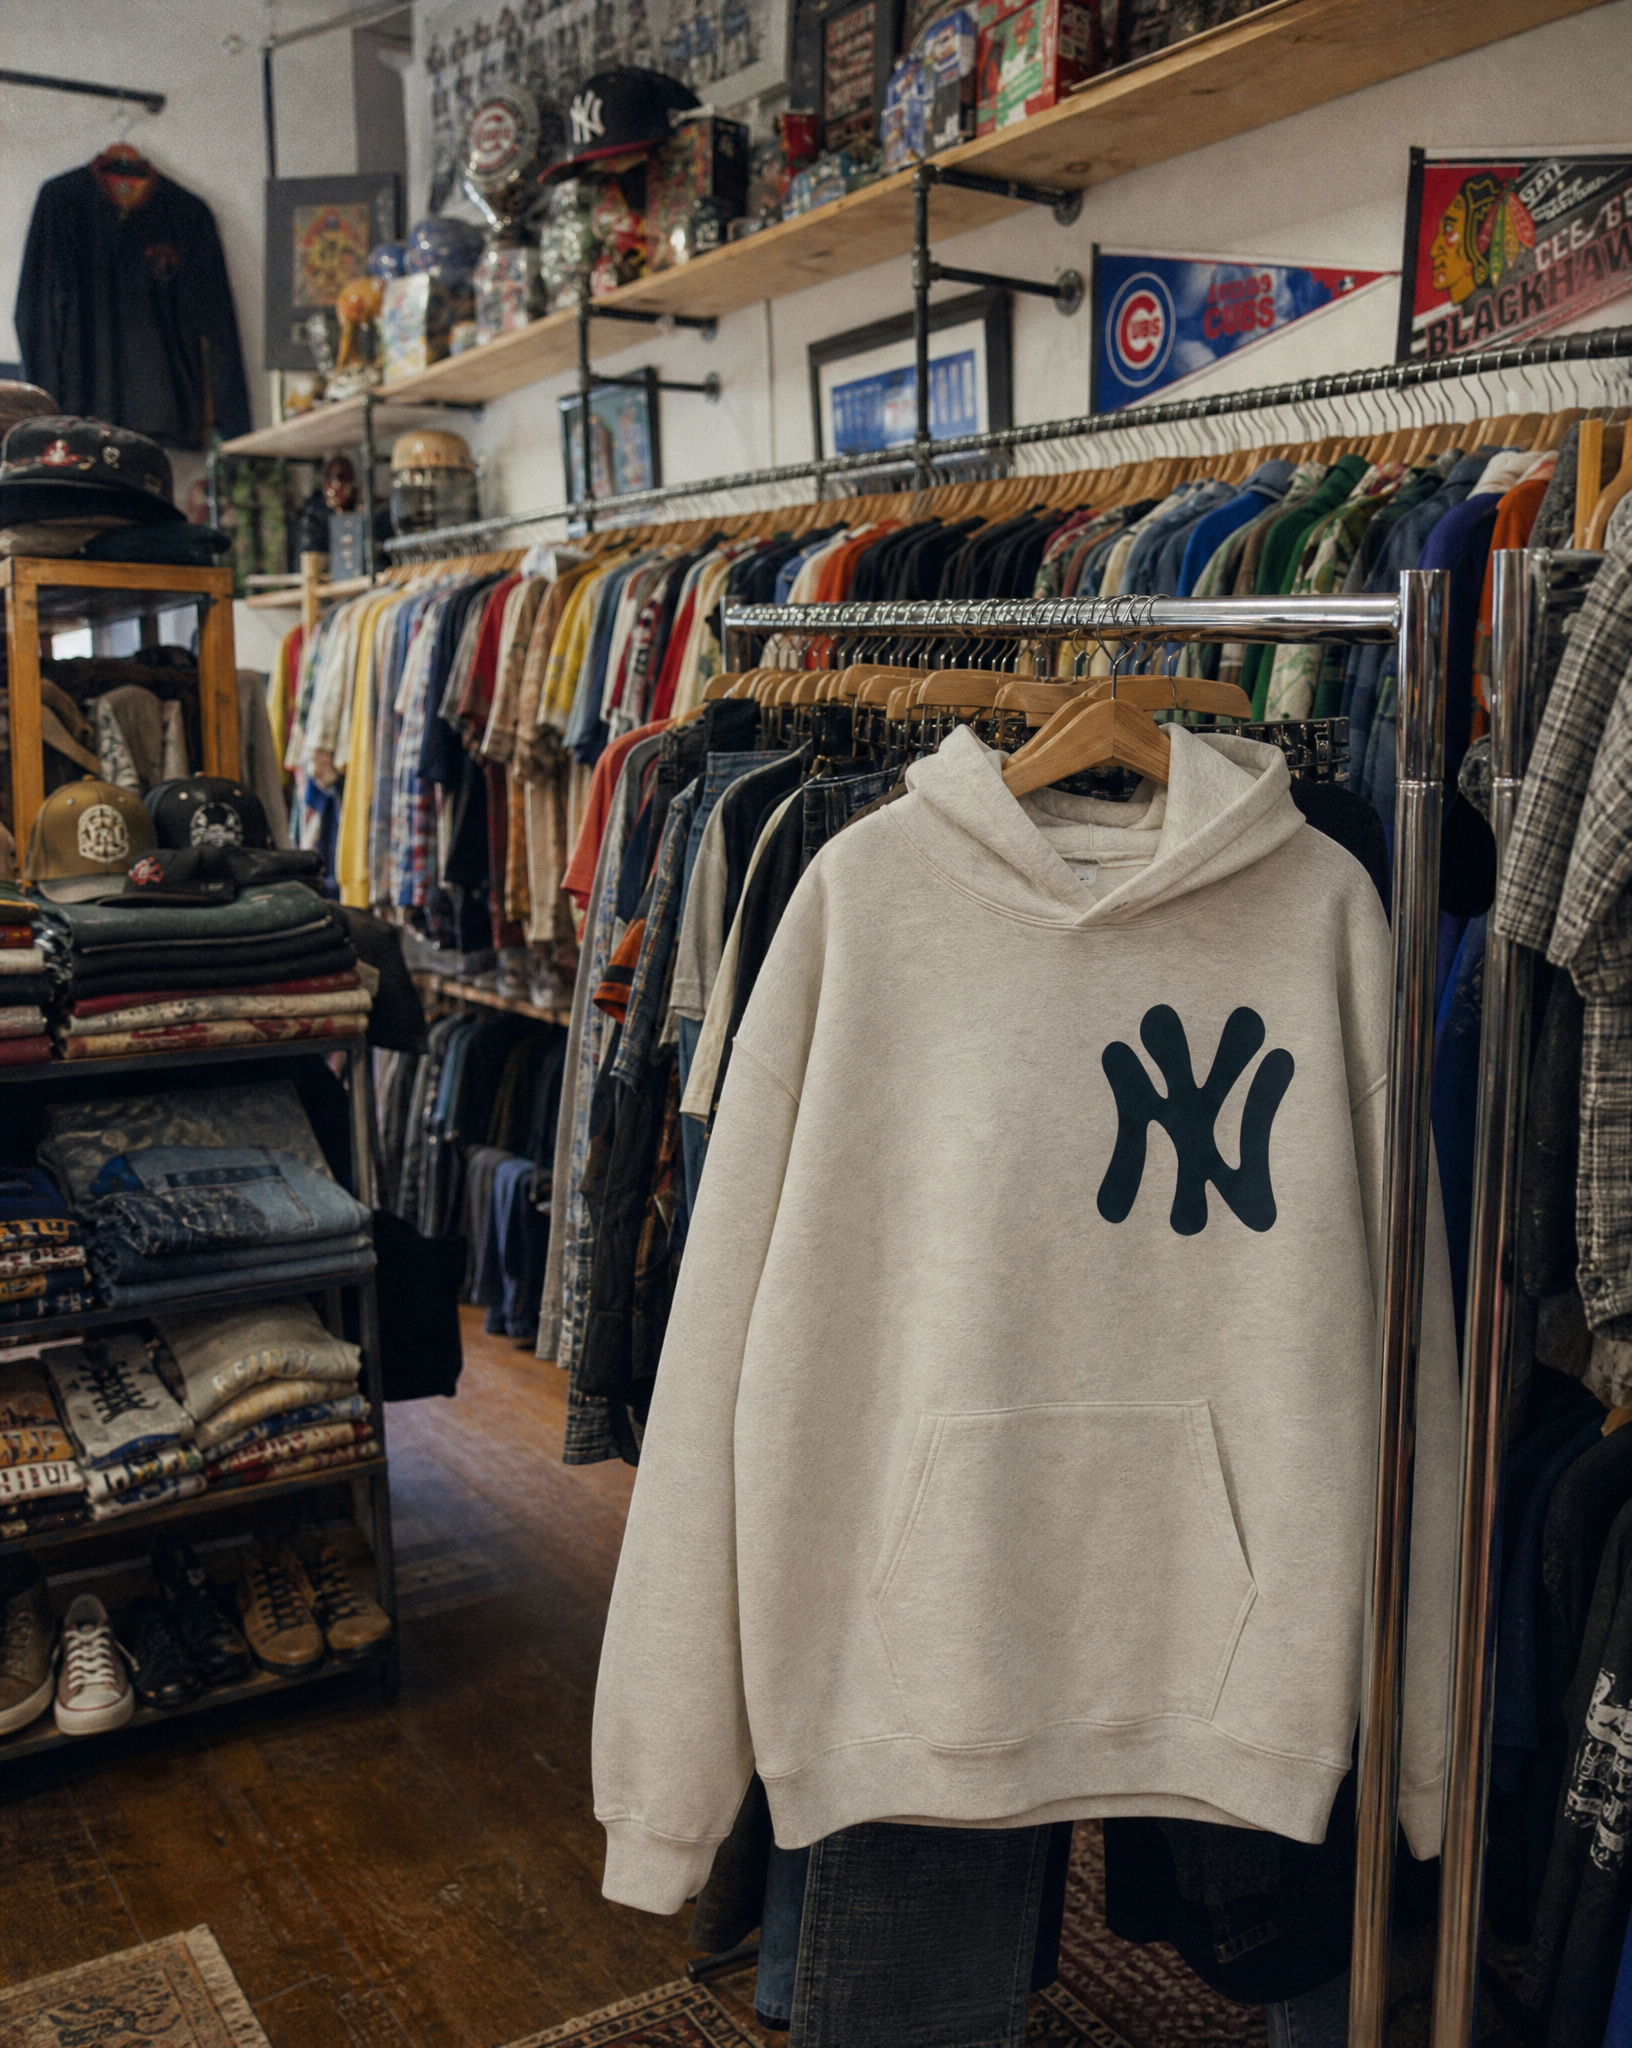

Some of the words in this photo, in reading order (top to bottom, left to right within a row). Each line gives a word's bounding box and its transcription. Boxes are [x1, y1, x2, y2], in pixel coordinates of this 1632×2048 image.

[570, 89, 606, 145] NY
[1203, 297, 1276, 340] CUBS
[1097, 1003, 1296, 1236] NY
